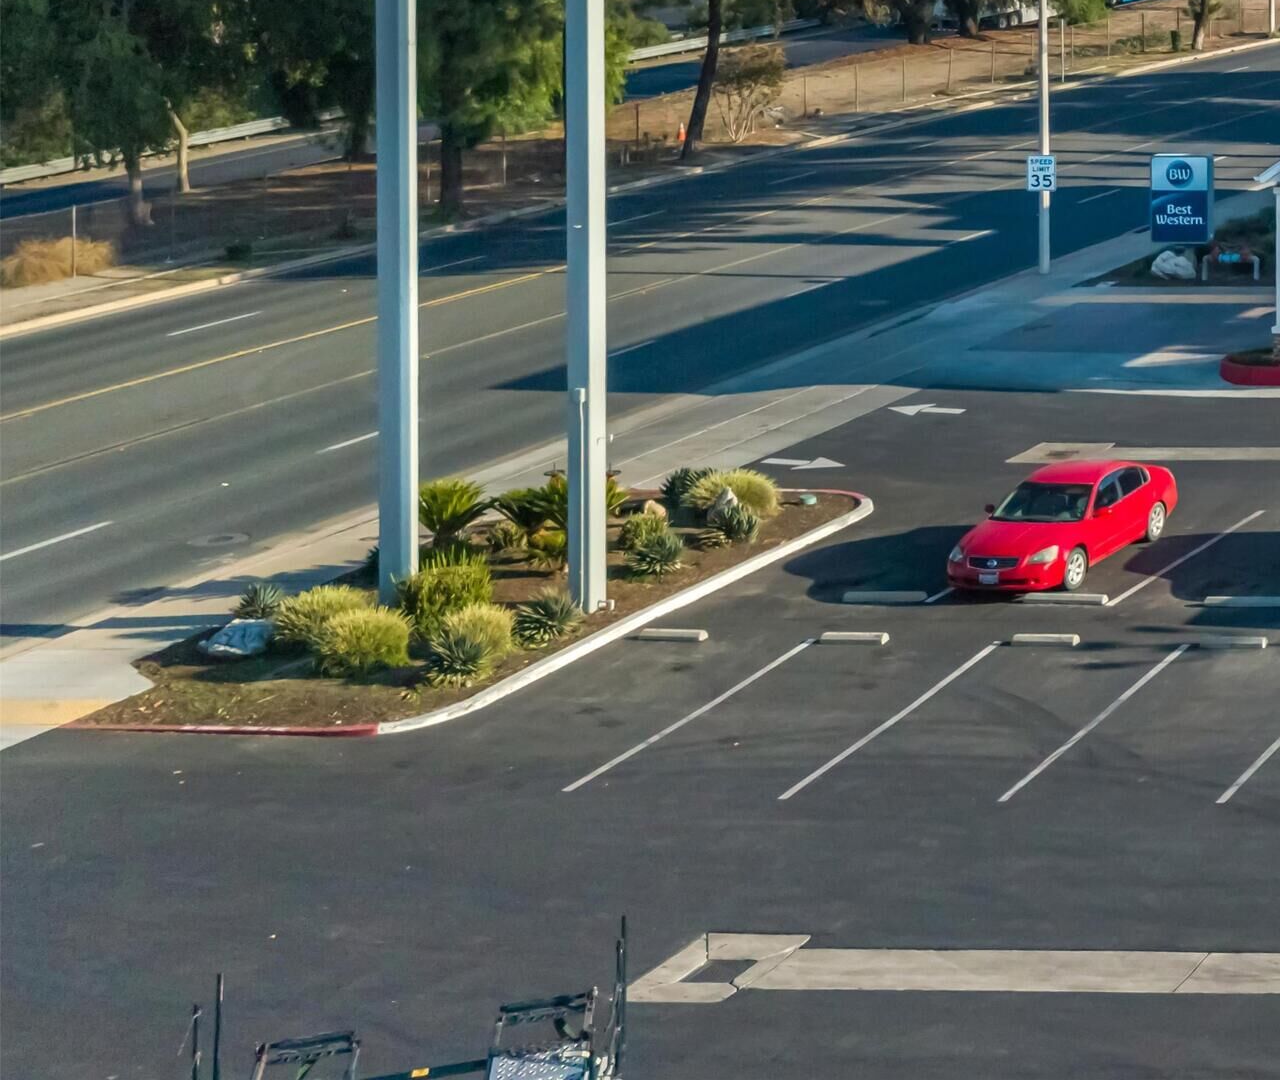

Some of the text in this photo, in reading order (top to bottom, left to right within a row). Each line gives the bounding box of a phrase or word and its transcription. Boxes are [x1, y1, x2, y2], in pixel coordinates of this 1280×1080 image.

[1169, 168, 1190, 180] BW
[1031, 174, 1052, 188] 35
[1167, 204, 1192, 215] Best
